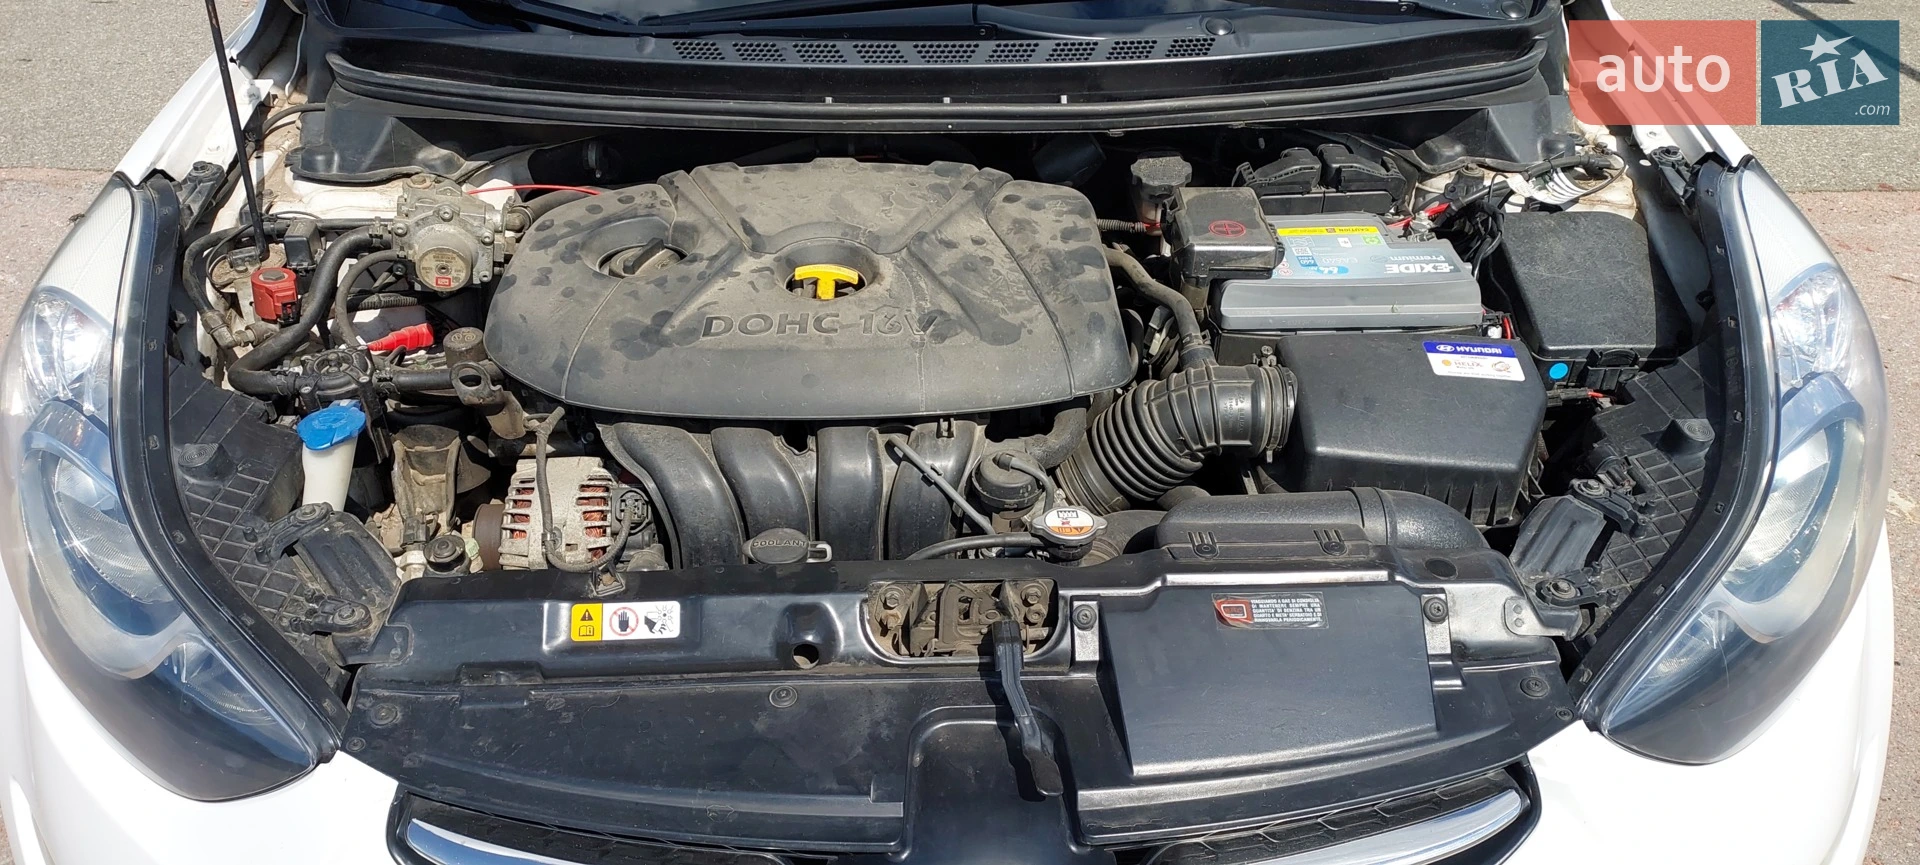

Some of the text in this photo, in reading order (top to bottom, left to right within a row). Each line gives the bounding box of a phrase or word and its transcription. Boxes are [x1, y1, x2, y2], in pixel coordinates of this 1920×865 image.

[1319, 266, 1339, 274] 64
[1384, 262, 1453, 274] EXIDE
[701, 312, 939, 338] DOHC 16V
[1456, 345, 1502, 355] HYUNDAI
[752, 539, 807, 548] COOLANT
